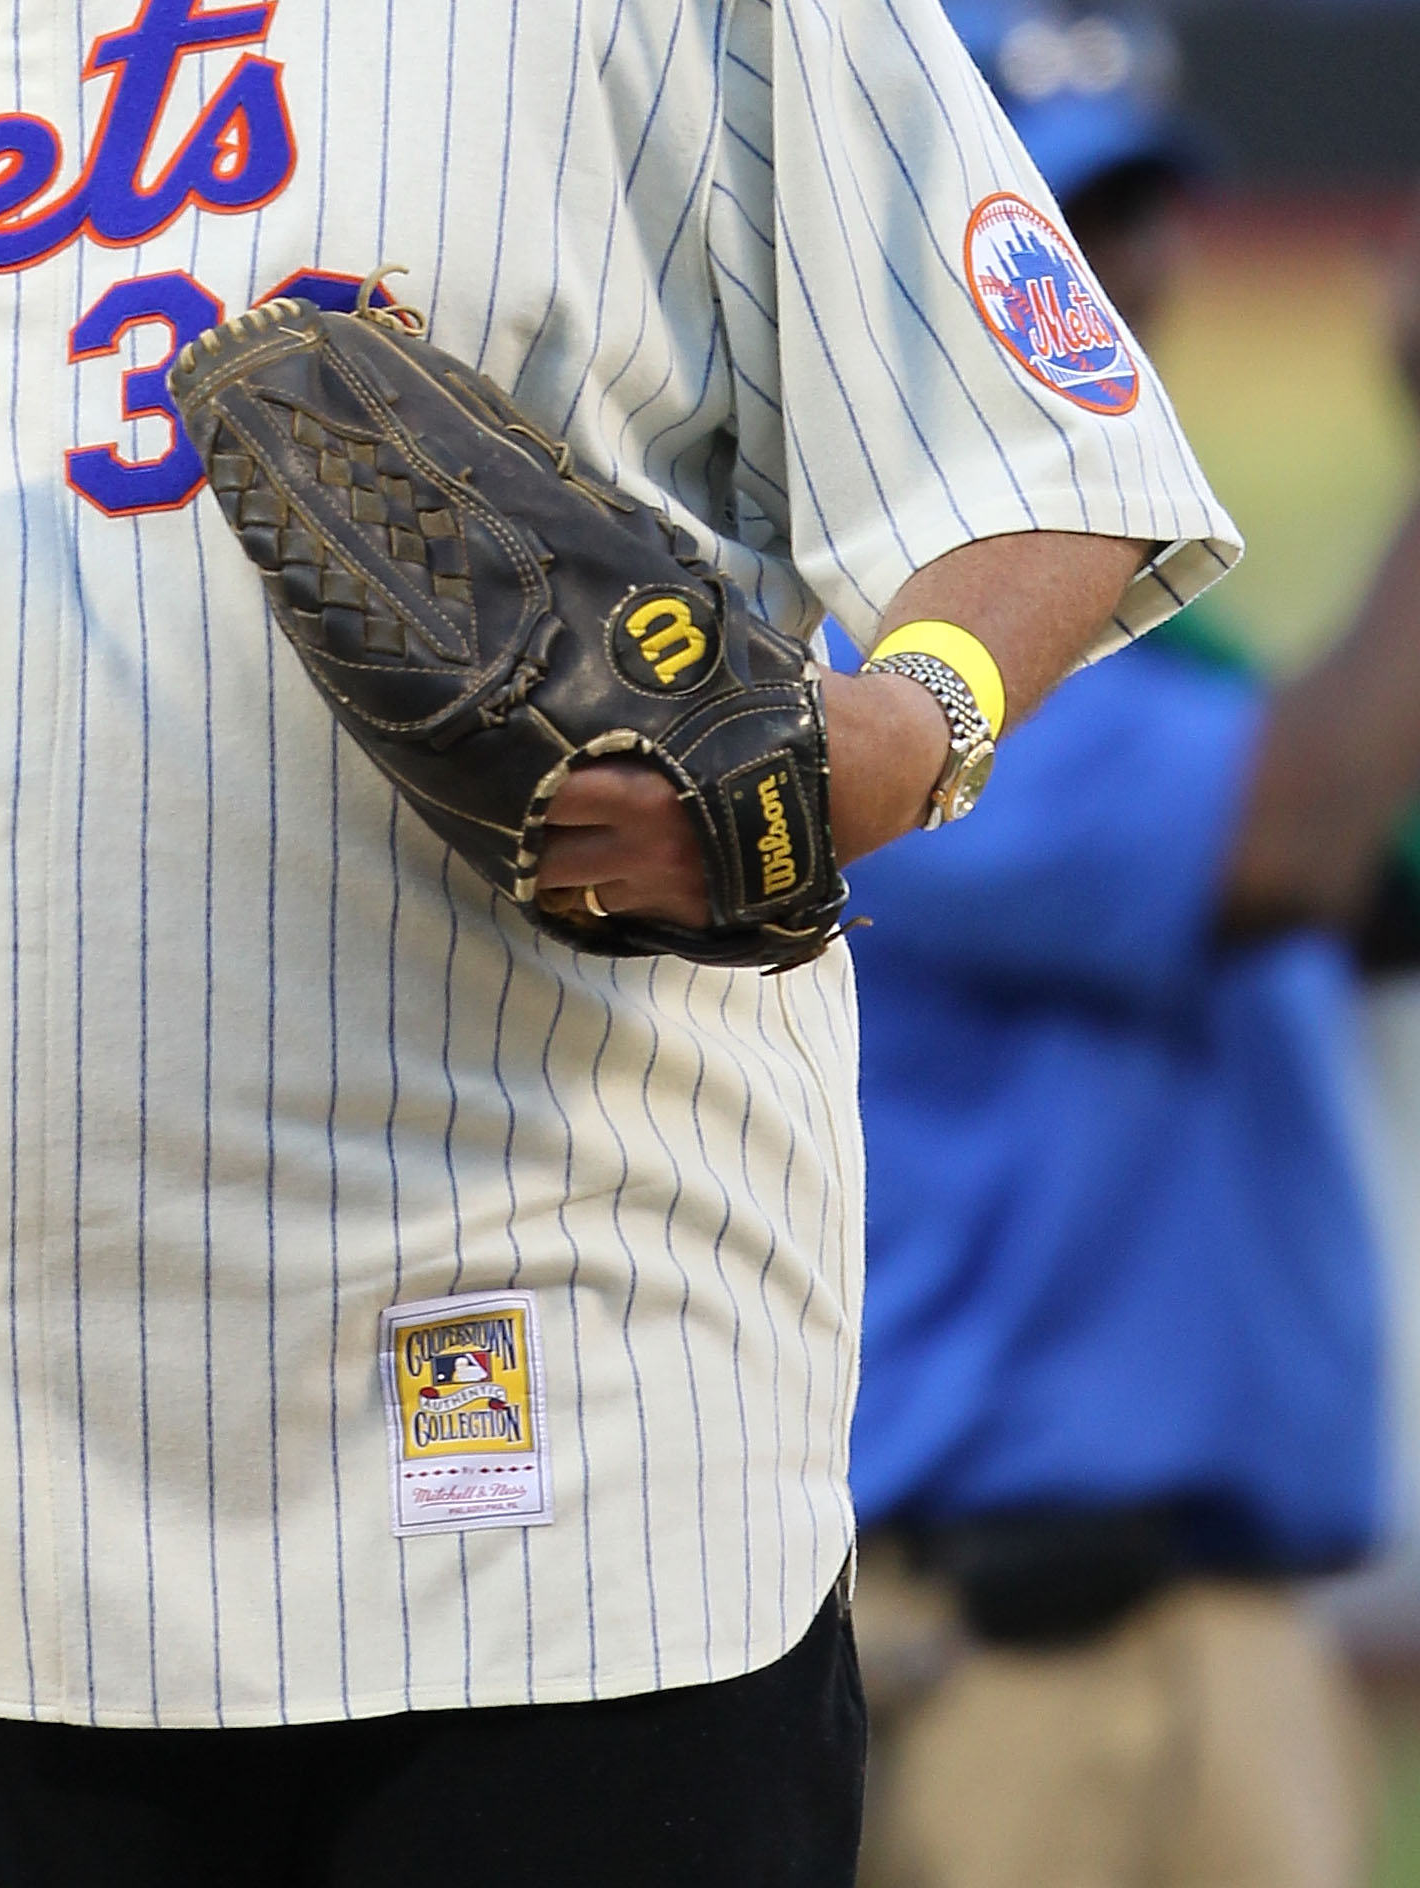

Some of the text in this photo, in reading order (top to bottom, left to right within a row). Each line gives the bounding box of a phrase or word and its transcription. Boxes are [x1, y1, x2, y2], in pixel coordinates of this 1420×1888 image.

[1028, 276, 1114, 359] Mets
[757, 774, 797, 896] Wilson
[414, 1404, 522, 1447] COLLECTION
[422, 1385, 506, 1411] AUTHENTIC
